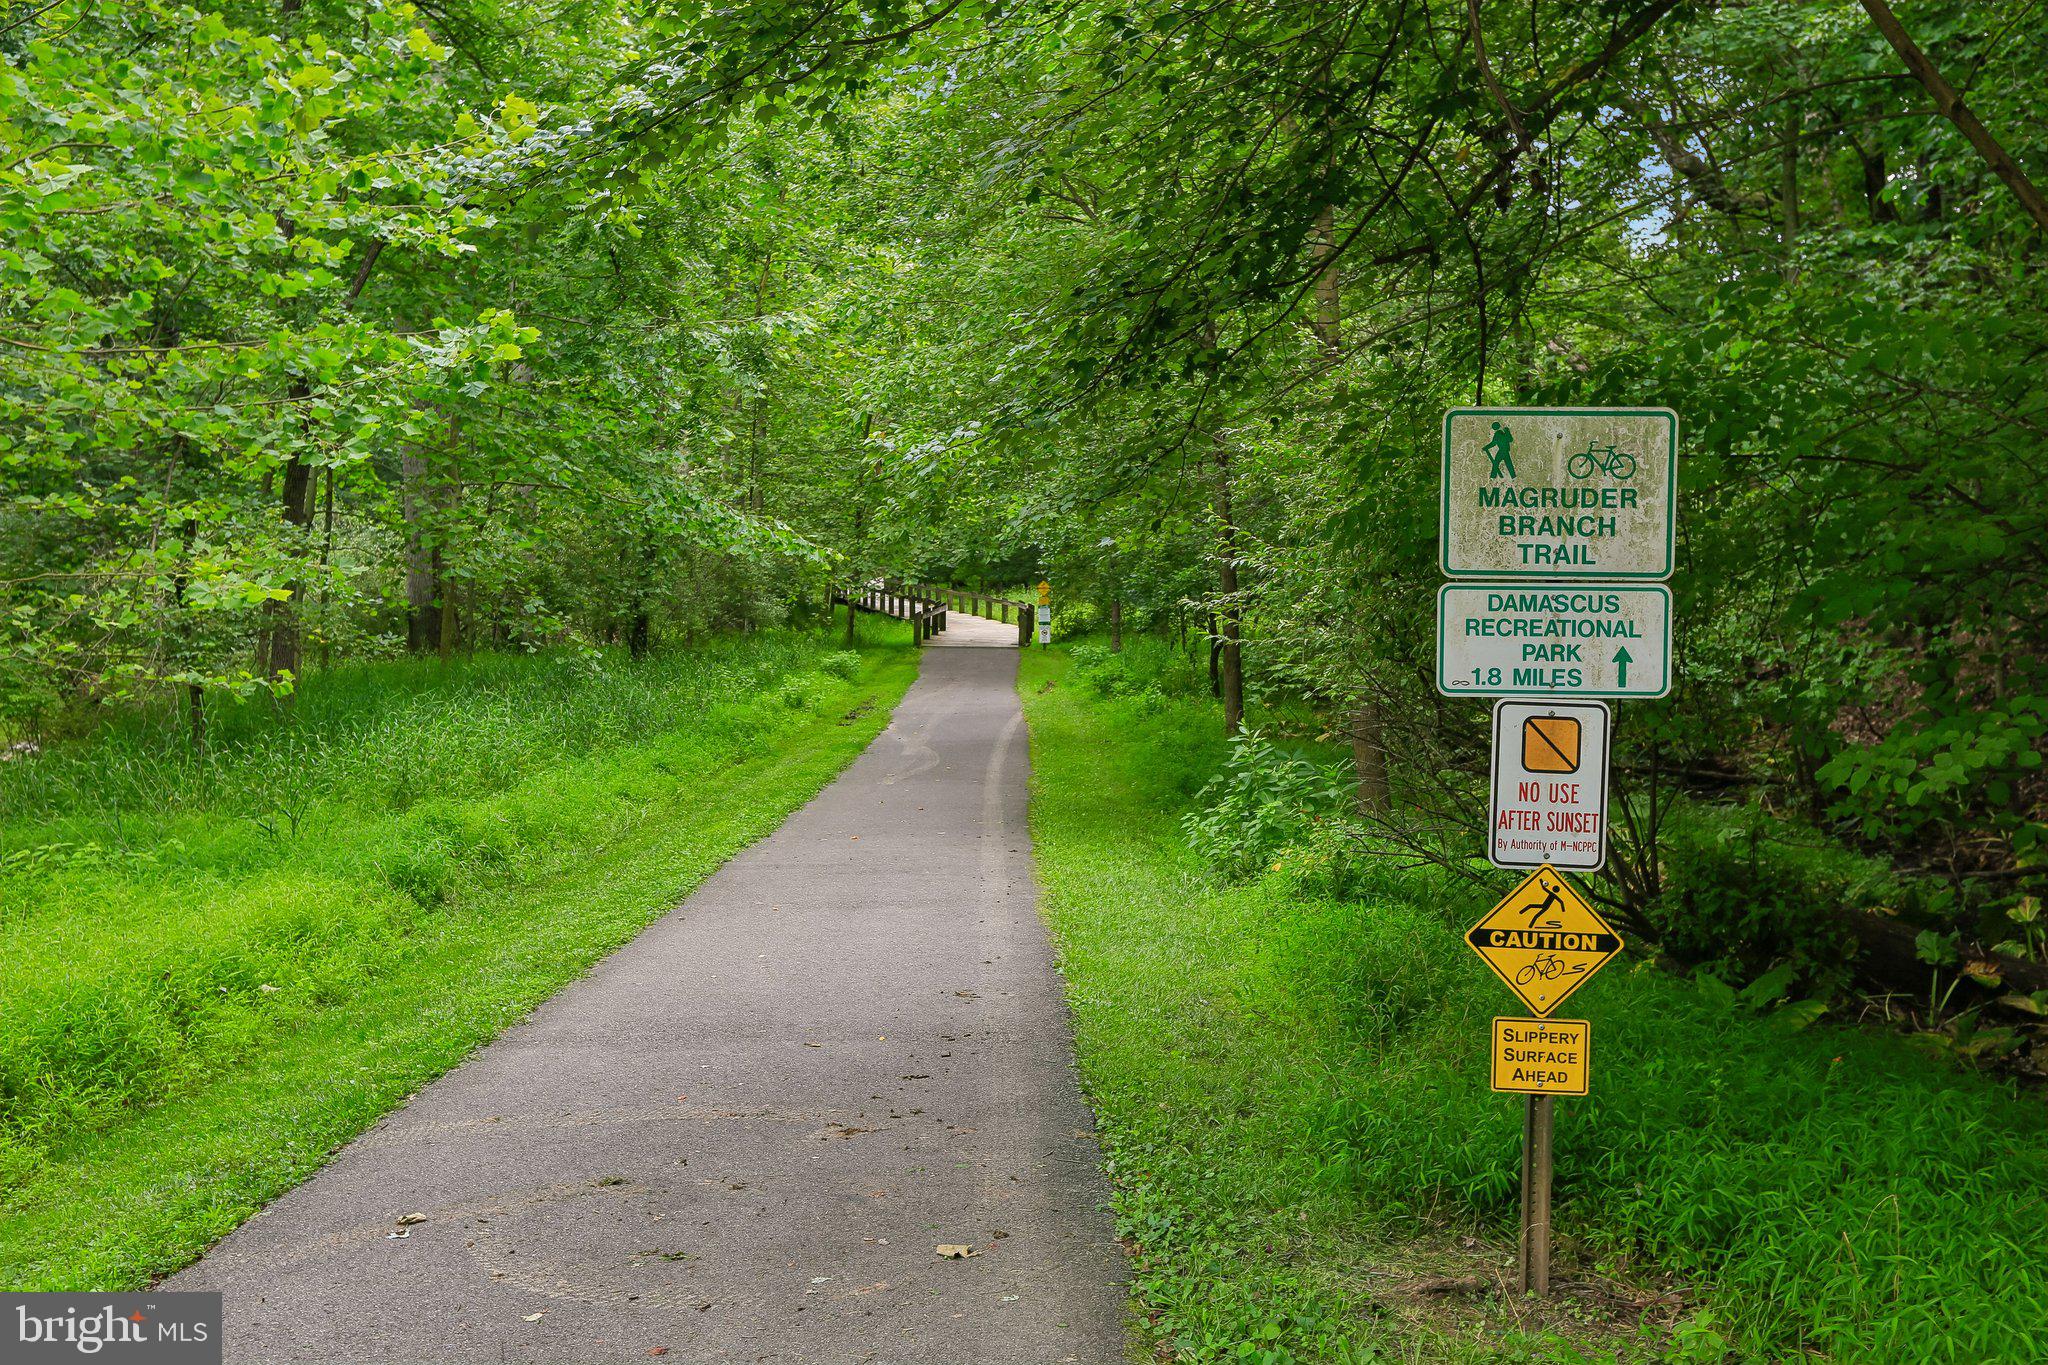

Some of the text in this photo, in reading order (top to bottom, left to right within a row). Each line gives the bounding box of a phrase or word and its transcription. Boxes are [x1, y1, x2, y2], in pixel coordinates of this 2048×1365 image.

[1478, 487, 1638, 509] MAGRUDER
[1500, 515, 1616, 537] BRANCH
[1517, 544, 1596, 565] TRAIL
[1488, 594, 1620, 613] DAMASCUS
[1465, 618, 1642, 638] RECREATIONAL
[1522, 643, 1582, 662] PARK
[1471, 668, 1582, 687] 1.8 MILES
[1518, 782, 1580, 804] NO USE
[1498, 810, 1598, 833] AFTER SUNSET
[1497, 839, 1597, 853] By Authority of M-NCPPC
[1489, 931, 1598, 951] CAUTION
[1503, 1028, 1579, 1045] SLIPPERY
[1504, 1048, 1577, 1064] SURFACE
[1512, 1068, 1568, 1084] AHEAD
